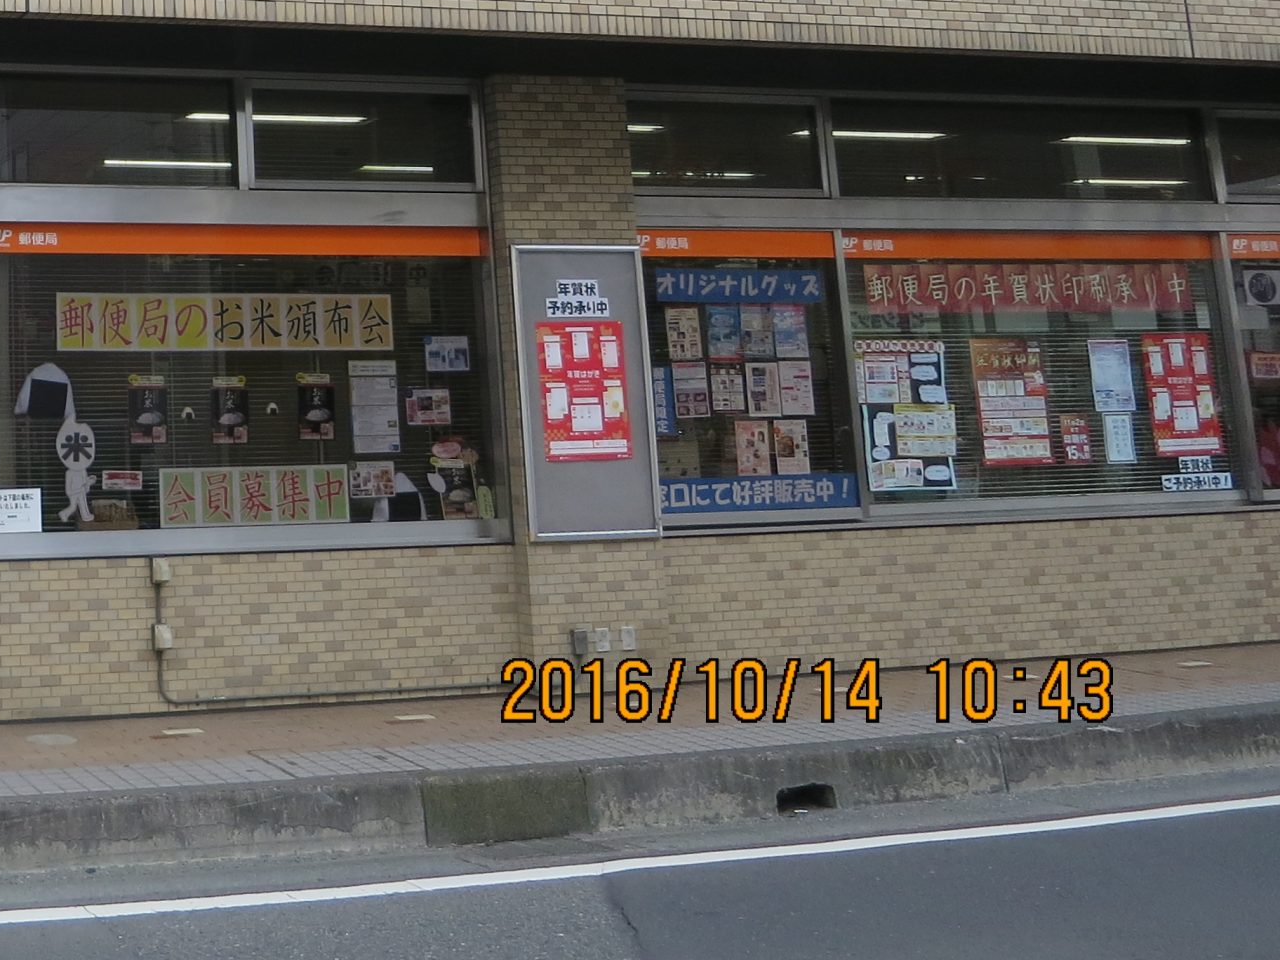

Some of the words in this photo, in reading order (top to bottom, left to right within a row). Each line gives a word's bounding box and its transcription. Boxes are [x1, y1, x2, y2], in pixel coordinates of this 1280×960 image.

[18, 232, 58, 245] 郵便局
[655, 237, 688, 249] 郵便局
[863, 239, 894, 251] 郵便局
[558, 282, 597, 297] 年賀状
[656, 272, 819, 296] オリジナルグッズ
[869, 271, 1187, 310] 郵便局の年賀状印刷承り中
[547, 300, 608, 315] 予約承り中
[58, 297, 391, 348] 郵便局のお米頒布会
[61, 431, 94, 462] 米
[1180, 458, 1212, 471] 年賀状
[165, 471, 345, 524] 会員募集中
